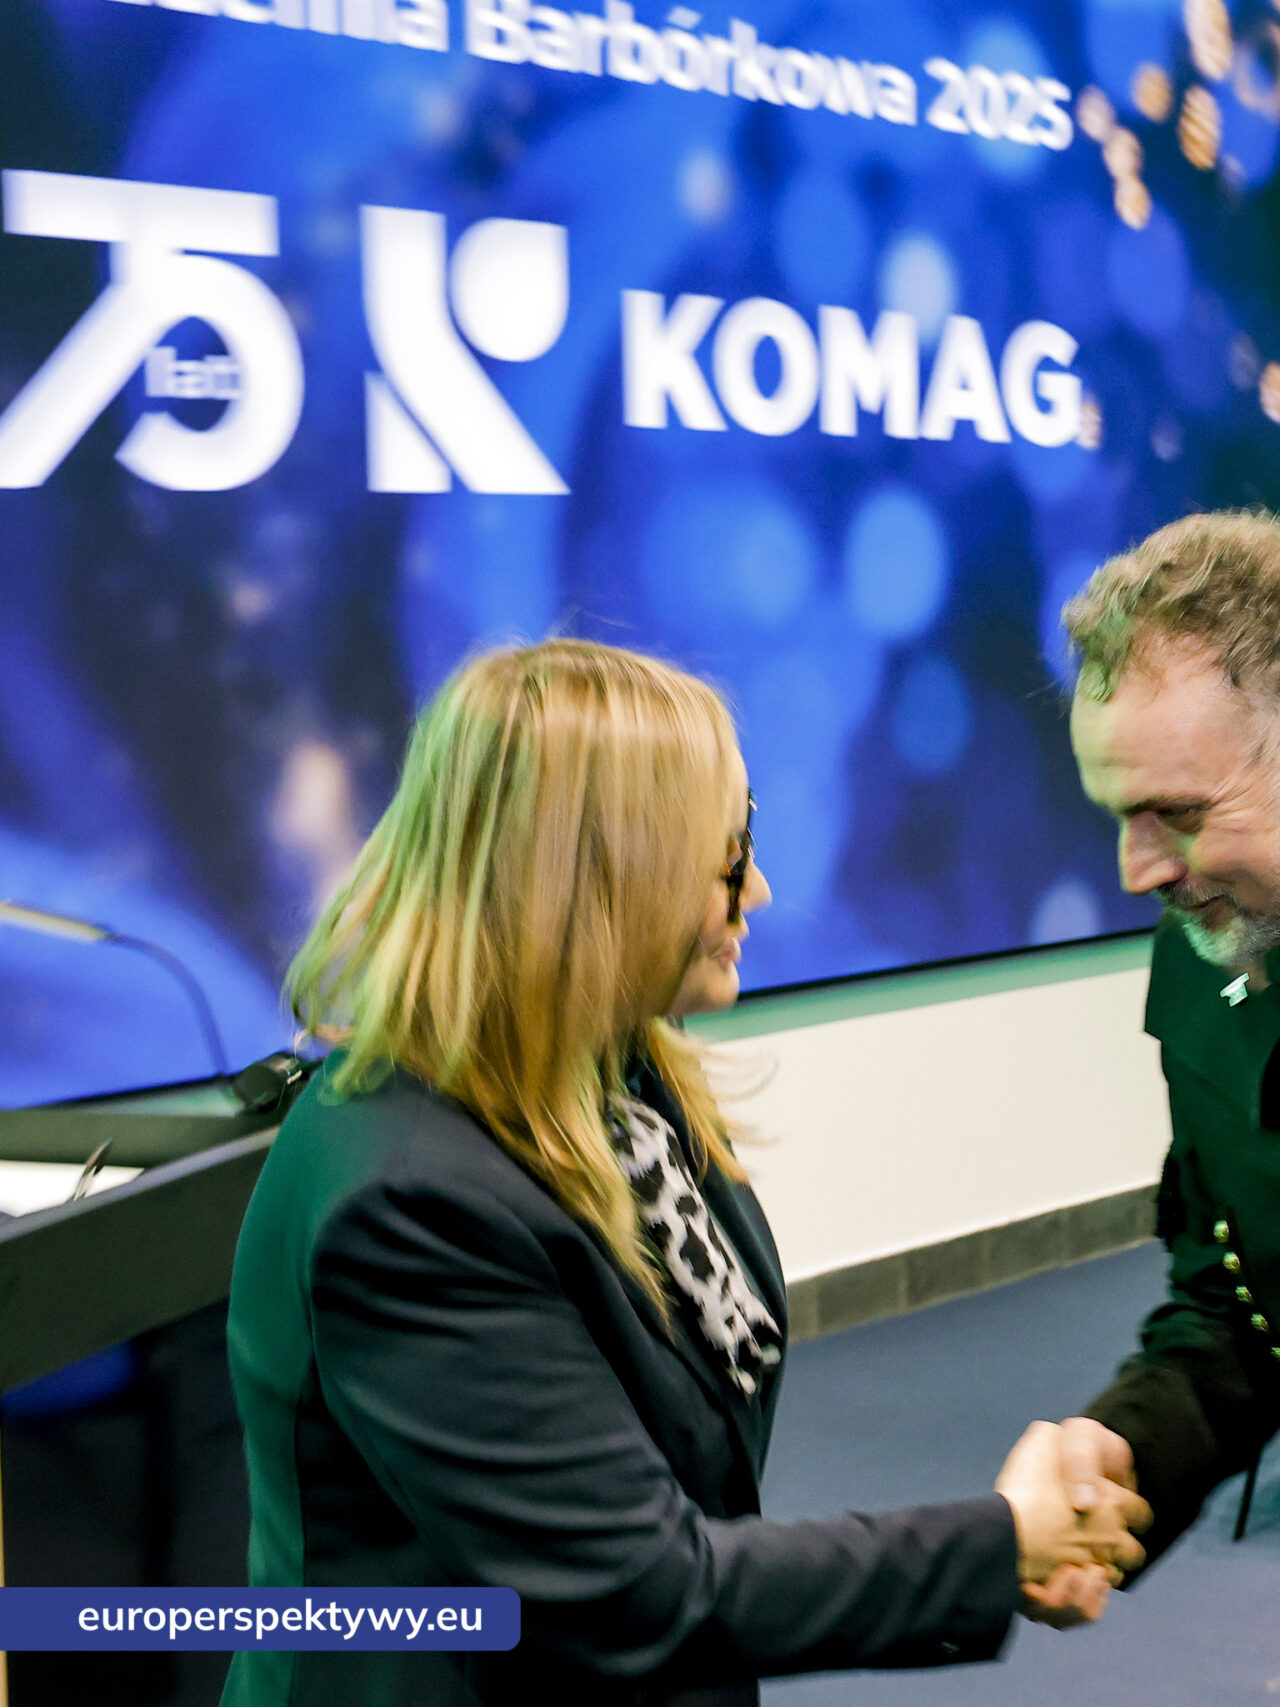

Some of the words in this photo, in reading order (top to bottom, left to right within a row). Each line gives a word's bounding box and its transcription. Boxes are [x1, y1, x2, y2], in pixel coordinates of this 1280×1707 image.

[465, 0, 917, 126] Barbórkowa
[924, 58, 1073, 150] 2025
[621, 289, 1082, 447] KOMAG
